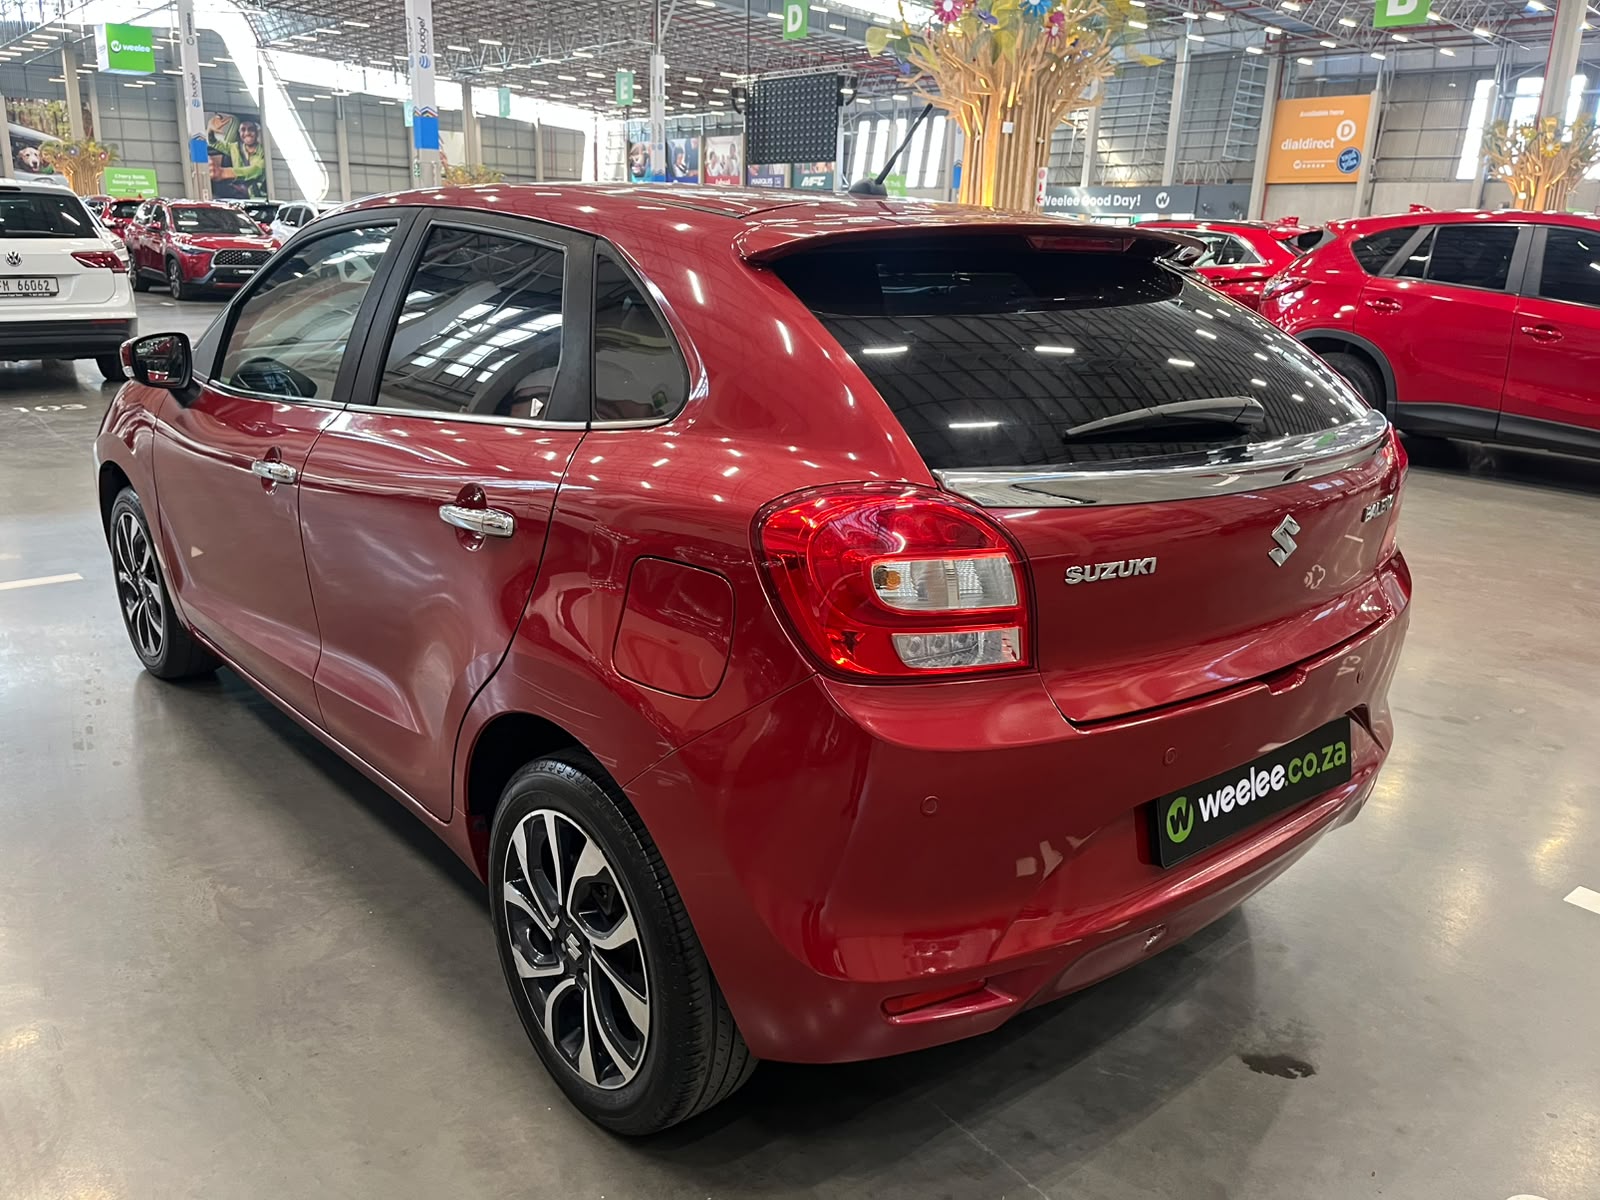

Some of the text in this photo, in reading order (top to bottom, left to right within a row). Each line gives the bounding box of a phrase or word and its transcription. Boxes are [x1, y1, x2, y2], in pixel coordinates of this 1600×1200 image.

[787, 4, 803, 32] D
[122, 43, 151, 53] weelee
[620, 77, 629, 99] E
[1281, 138, 1335, 150] dialdirect
[801, 176, 826, 187] MFC
[1082, 194, 1112, 207] Good
[1113, 194, 1141, 209] Day!
[0, 279, 50, 291] M 66062
[1064, 557, 1157, 584] SUZUKI
[1198, 741, 1347, 822] weelee.co.za
